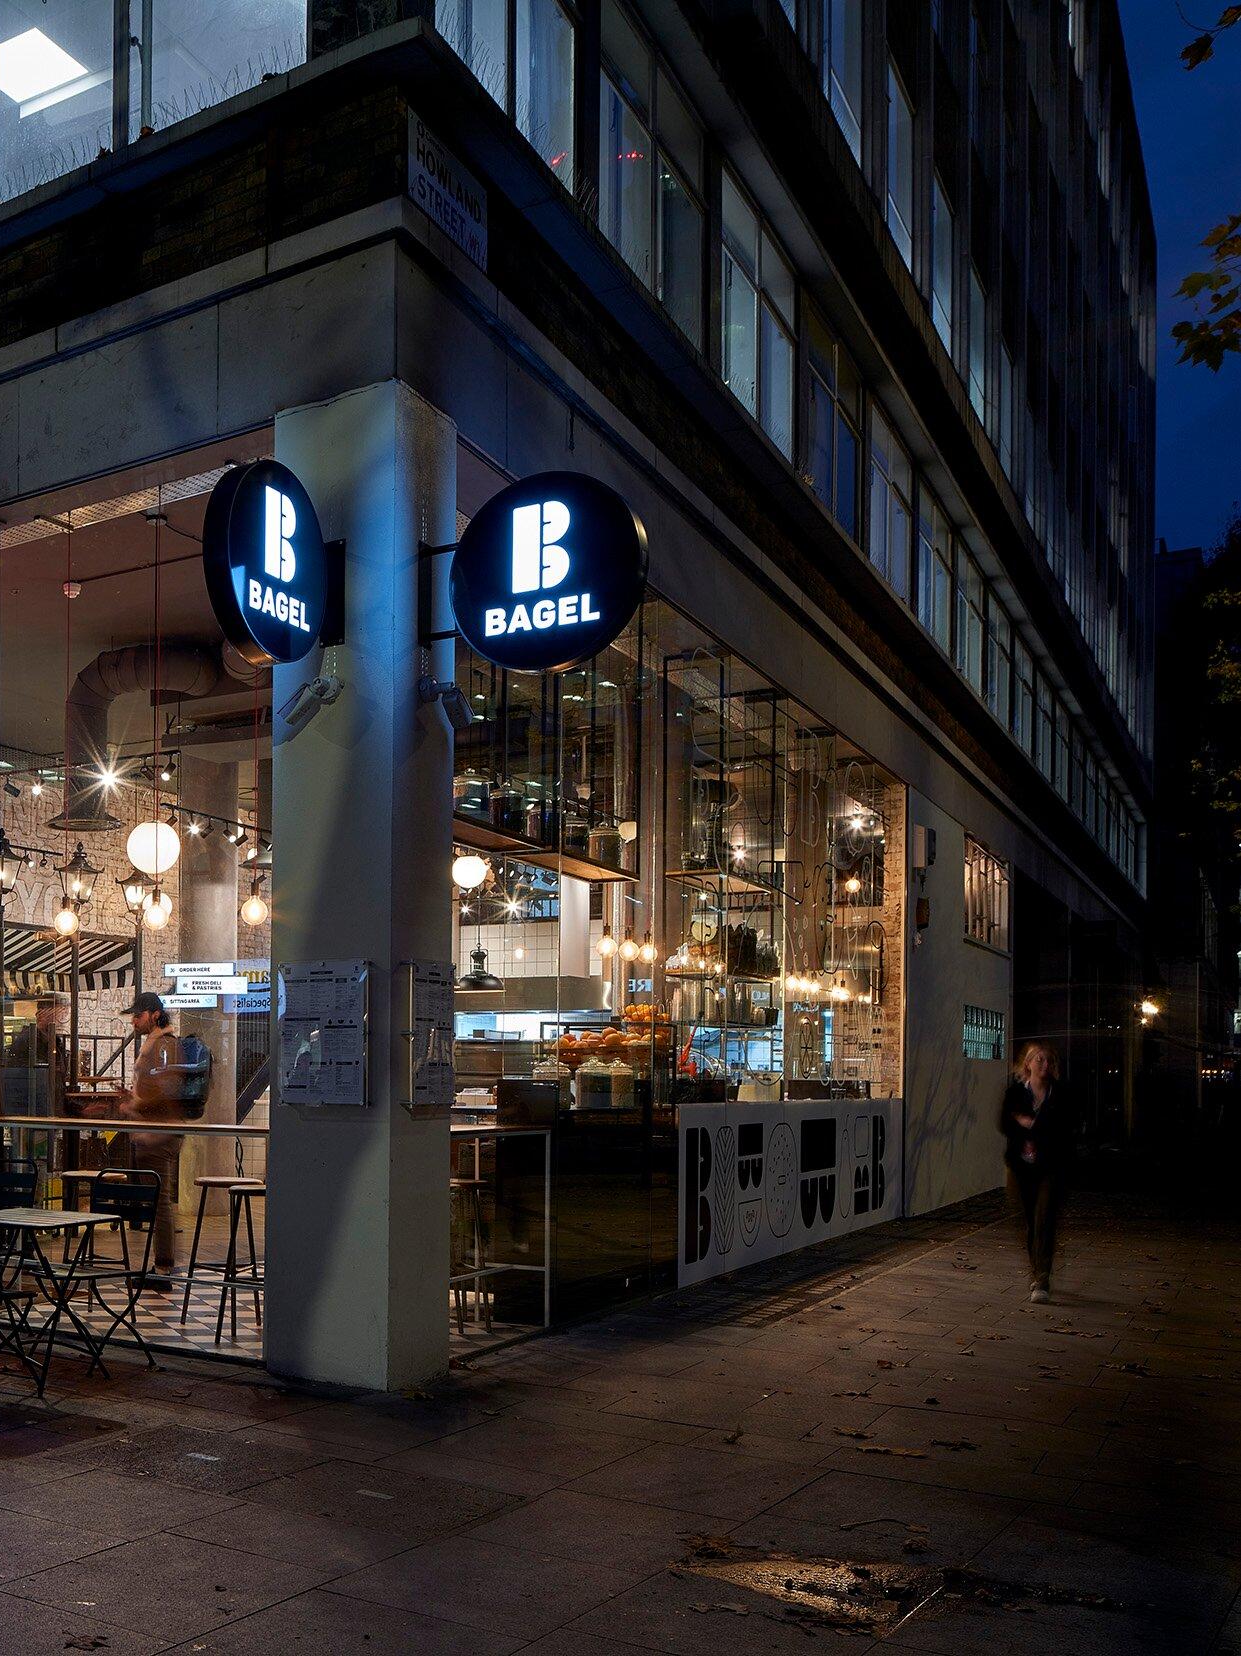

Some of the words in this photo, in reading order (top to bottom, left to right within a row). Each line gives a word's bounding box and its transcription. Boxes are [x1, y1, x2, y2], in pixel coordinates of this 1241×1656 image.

[416, 138, 482, 224] HOWLAND
[417, 173, 467, 248] STREET
[263, 485, 297, 583] B
[510, 500, 571, 594] B
[248, 578, 311, 633] BAGEL
[484, 593, 601, 637] BAGEL
